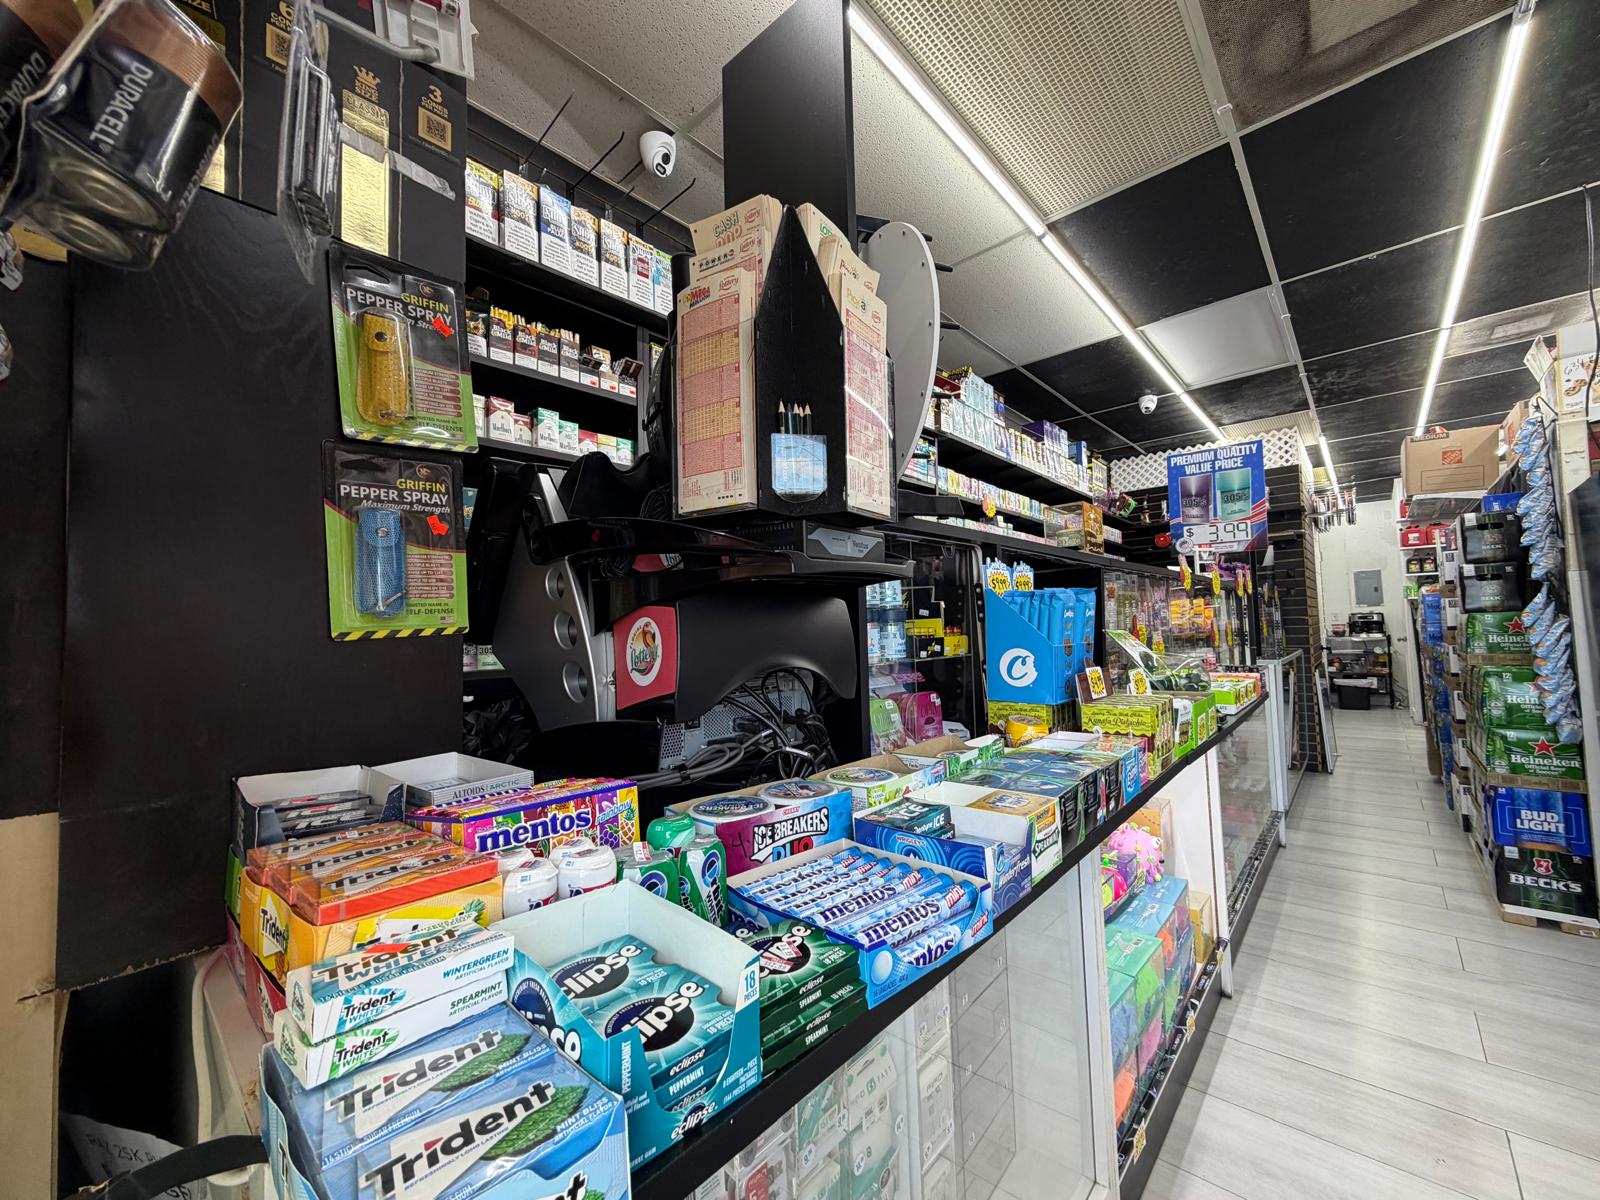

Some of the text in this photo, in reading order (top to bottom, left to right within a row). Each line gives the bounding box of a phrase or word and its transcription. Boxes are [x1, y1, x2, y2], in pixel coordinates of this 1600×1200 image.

[89, 61, 154, 146] DURACELL
[421, 96, 449, 114] CONES
[428, 85, 443, 103] 3
[713, 211, 739, 238] CASH
[690, 287, 711, 300] MEGA
[720, 277, 738, 291] Lottery
[346, 288, 404, 314] PEPPER
[401, 292, 449, 313] GRIFFIN
[1413, 432, 1447, 441] MEDIUM
[1170, 443, 1258, 467] PREMIUM QUALITY
[1185, 457, 1243, 475] VALUE PRICE
[339, 484, 448, 505] PEPPER SPRAY
[396, 479, 446, 492] GRIFFIN
[360, 499, 450, 514] Maximum Strength
[1186, 522, 1249, 542] $ 3.99
[630, 645, 659, 673] Lottery
[1507, 695, 1539, 704] Hein
[1511, 755, 1581, 768] Heineken
[453, 779, 520, 799] ALTOIDS ARCTIC
[596, 799, 633, 825] rainbow
[933, 813, 945, 829] ICE
[1521, 810, 1559, 823] BUD
[477, 810, 592, 853] mentos
[754, 825, 774, 855] ICE
[775, 807, 829, 838] BREAKERS
[1517, 819, 1566, 833] LIGHT
[299, 839, 417, 871] Trident
[902, 872, 923, 890] mint
[1510, 873, 1583, 893] BECK'S
[820, 883, 897, 922] mentos
[944, 885, 966, 909] mint
[260, 908, 288, 948] Trident
[863, 899, 941, 943] mentos
[971, 909, 990, 938] mint
[318, 928, 461, 981] Trident
[442, 948, 510, 979] WINTERGREEN
[907, 937, 954, 966] ntos
[345, 946, 437, 983] WHITE
[455, 956, 510, 981] ARTIFICIAL FLAVOR
[647, 970, 667, 983] PIECES
[744, 969, 756, 993] 18
[799, 975, 824, 995] eclipse
[344, 990, 397, 1018] Trident
[448, 989, 503, 1017] ARTIFICIAL FLAVOR
[449, 981, 503, 1010] SPEARMINT
[743, 987, 758, 1003] PIECES
[799, 989, 822, 1009] SPEARMINT
[349, 1005, 386, 1025] WHITE
[806, 1010, 832, 1031] eclipse
[707, 1025, 717, 1035] 18
[805, 1024, 829, 1046] SPEARMINT
[336, 1030, 389, 1062] Trident
[498, 1054, 522, 1070] MINT
[523, 1042, 547, 1059] BLISS
[341, 1049, 378, 1069] WHITE
[621, 1040, 632, 1095] PEPPERMINT
[669, 1048, 706, 1077] eclipse
[330, 1029, 500, 1117] Trident
[668, 1065, 705, 1096] PEPPERMINT
[876, 1065, 893, 1083] FAST
[553, 1103, 614, 1145] ARTIFICIAL FLAVOR
[556, 1096, 609, 1133] MINT BLISS
[670, 1101, 716, 1140] eclipse
[365, 1082, 552, 1196] Trident
